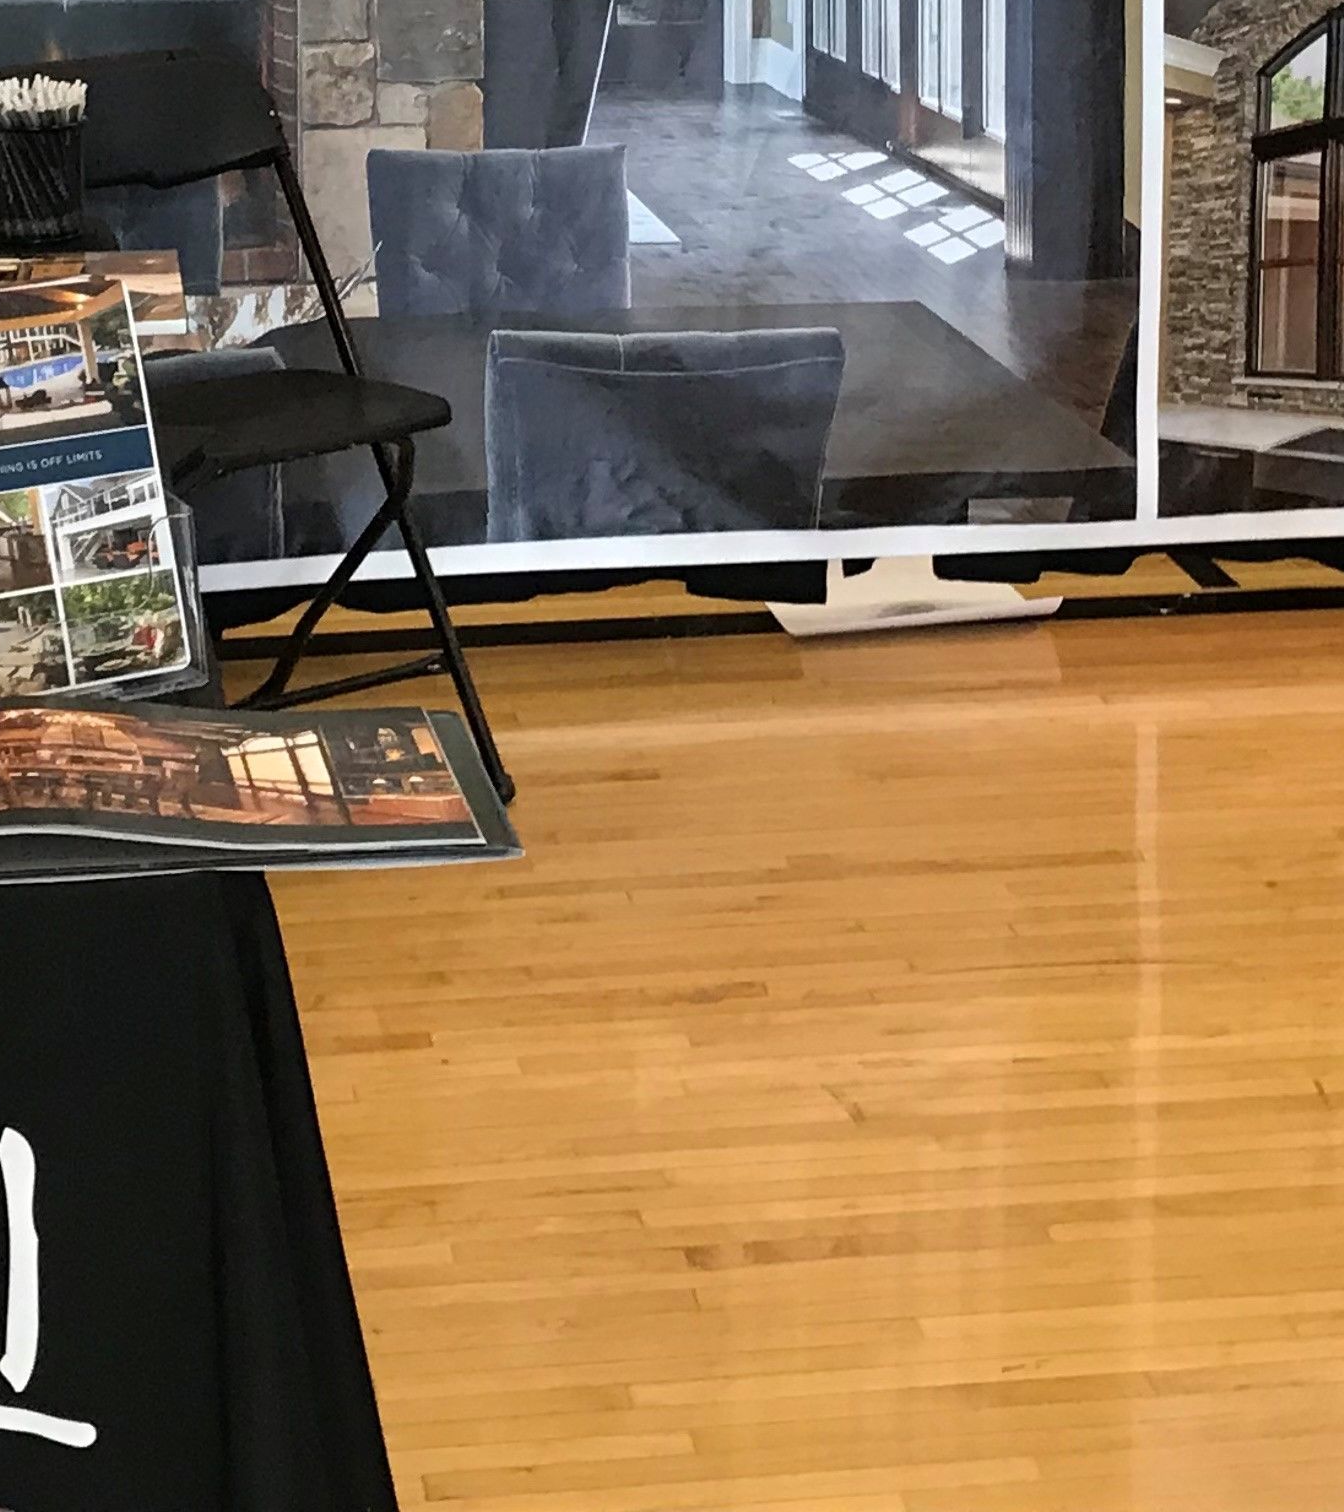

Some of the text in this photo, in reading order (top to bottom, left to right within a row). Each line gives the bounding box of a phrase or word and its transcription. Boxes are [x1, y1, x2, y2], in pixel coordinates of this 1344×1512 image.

[26, 459, 38, 471] IS
[40, 454, 63, 469] OFF
[66, 449, 103, 466] LIMITS
